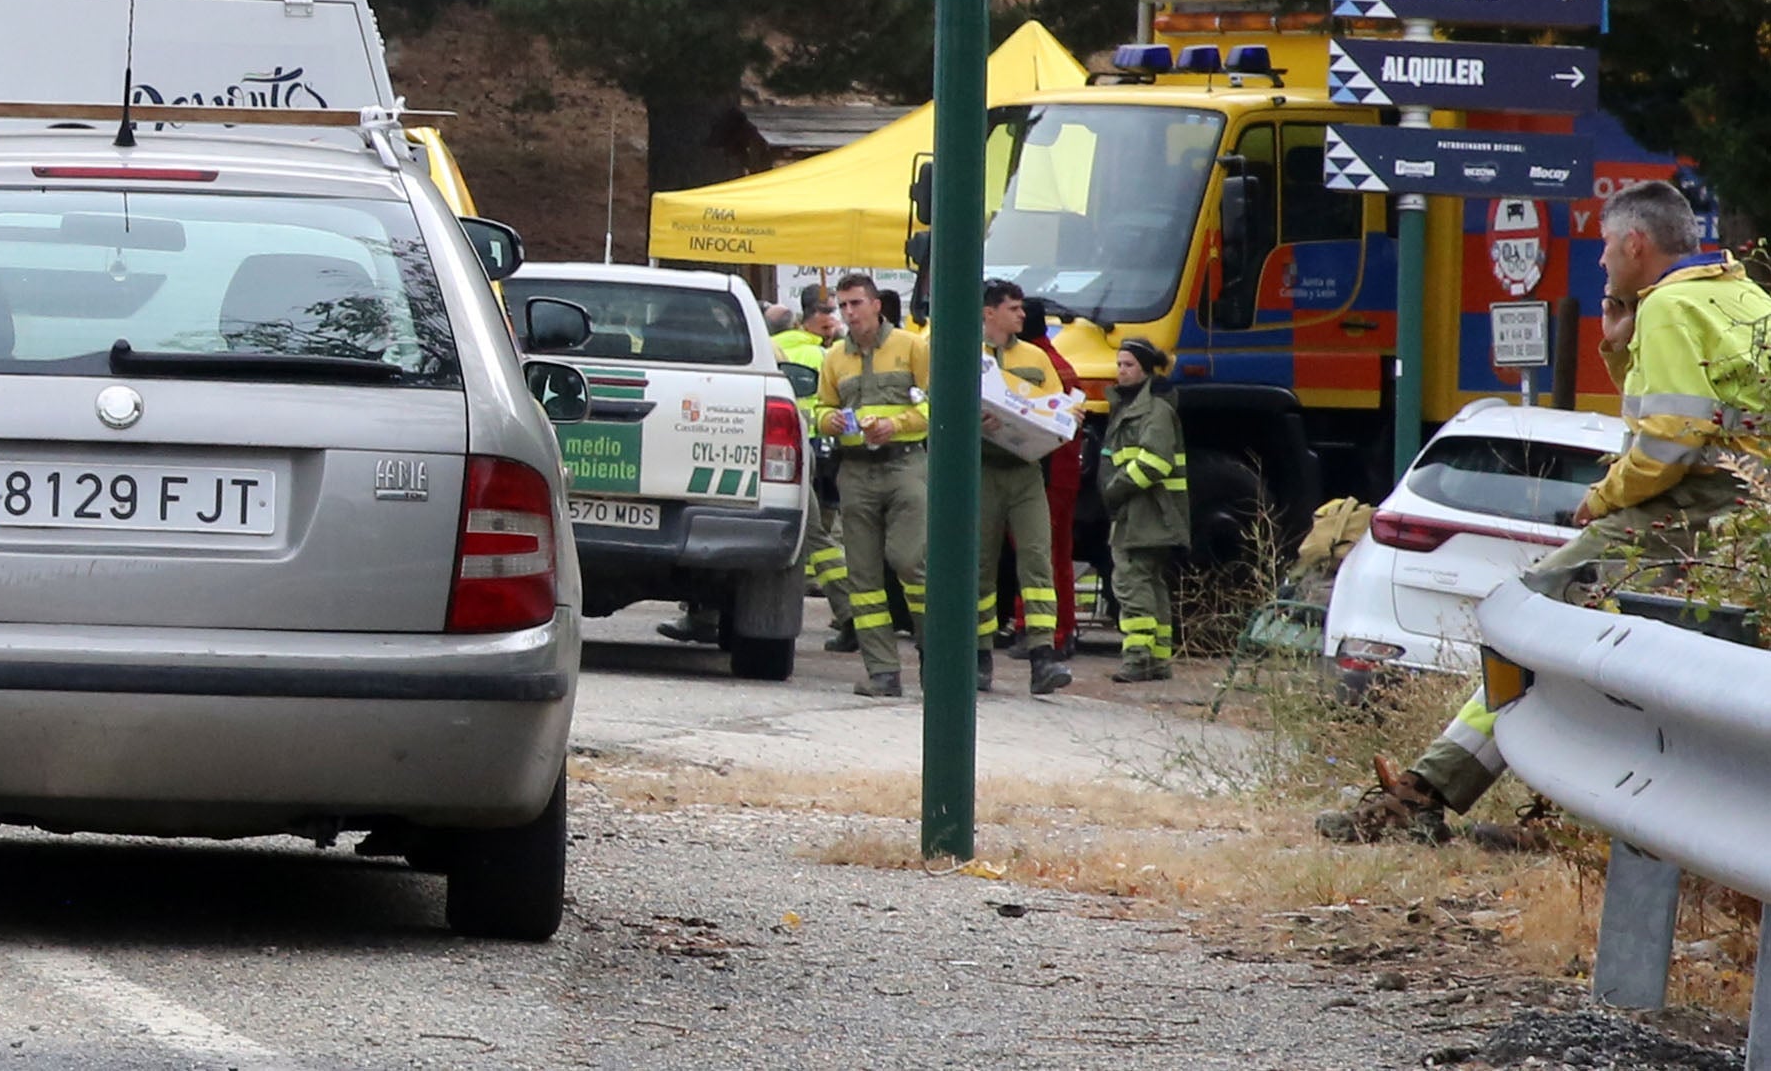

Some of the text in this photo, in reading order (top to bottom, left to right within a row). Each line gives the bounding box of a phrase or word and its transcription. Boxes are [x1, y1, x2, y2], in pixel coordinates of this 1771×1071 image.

[1382, 56, 1484, 87] ALQUILER
[1529, 166, 1570, 182] Mocay
[702, 207, 736, 221] PMA
[689, 236, 756, 254] INFOCAL
[674, 422, 710, 433] Castilla
[720, 425, 745, 435] León
[703, 415, 745, 425] Junta de
[565, 435, 622, 456] medio
[692, 441, 758, 465] CYL-1-075
[375, 459, 428, 489] FABIA
[564, 455, 637, 480] mbiente
[4, 471, 137, 521] 8129
[159, 476, 259, 525] FJT
[569, 501, 654, 526] 570 MDS
